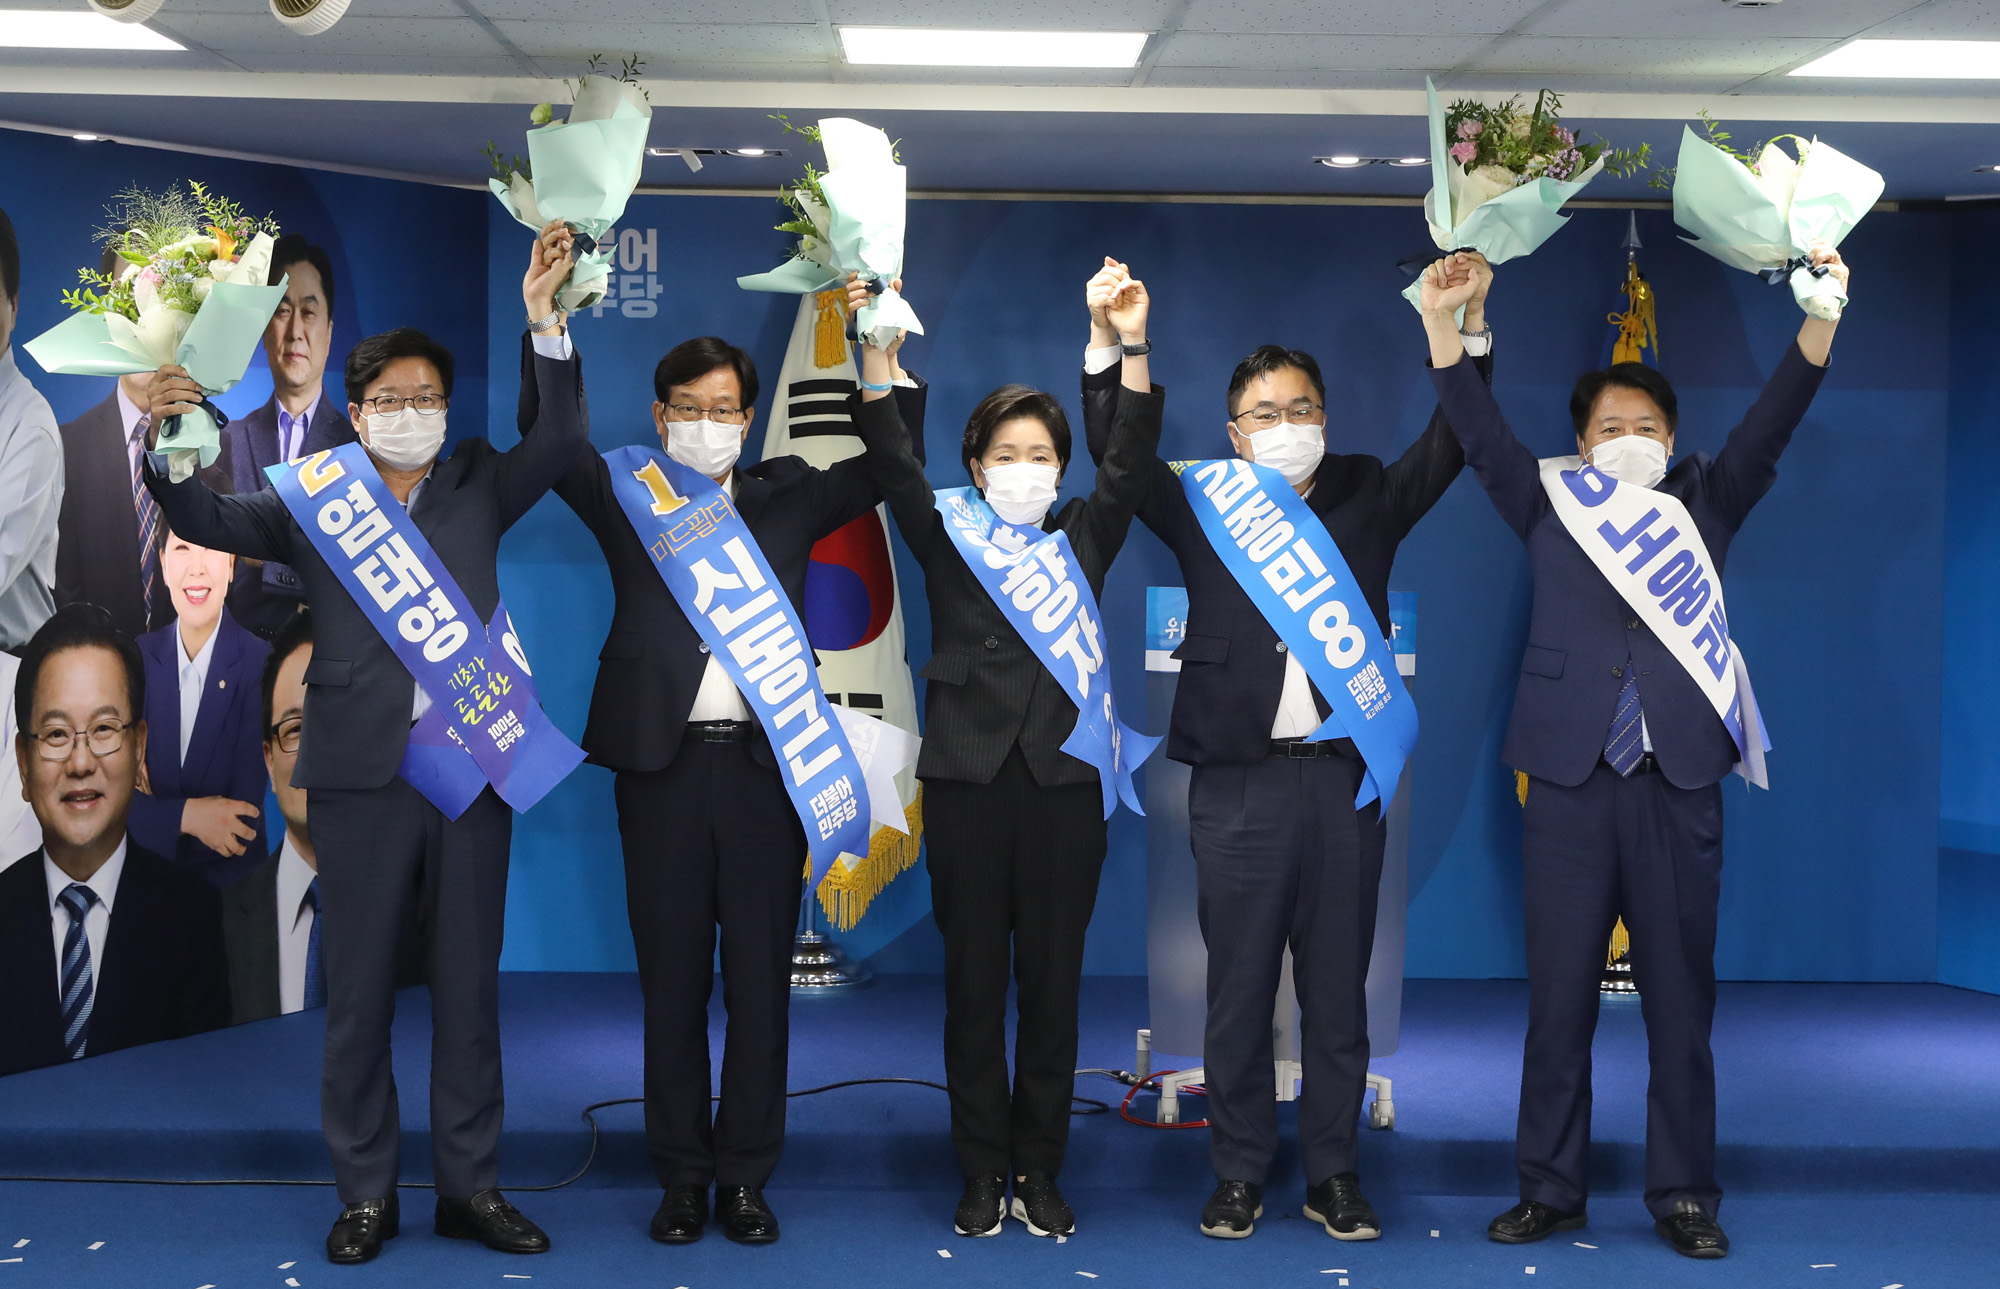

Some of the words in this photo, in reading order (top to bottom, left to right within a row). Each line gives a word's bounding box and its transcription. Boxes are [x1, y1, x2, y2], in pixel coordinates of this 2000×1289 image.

[288, 449, 346, 498] 2
[632, 457, 690, 517] 1
[1560, 460, 1618, 507] 6
[650, 494, 737, 562] 미드필더
[1194, 459, 1336, 613] 김종민
[317, 479, 468, 662] 염태영
[1597, 507, 1732, 682] 노웅래
[1308, 600, 1366, 669] 8
[447, 656, 485, 690] 기초가
[688, 536, 843, 787] 신동근
[1346, 660, 1380, 696] 더불어
[453, 672, 512, 725] 든든한
[1355, 675, 1387, 711] 민주당
[1365, 700, 1385, 720] 최고위원
[487, 709, 518, 740] 100년
[496, 722, 525, 752] 민주당
[809, 774, 853, 819] 더불어
[818, 796, 857, 841] 민주당
